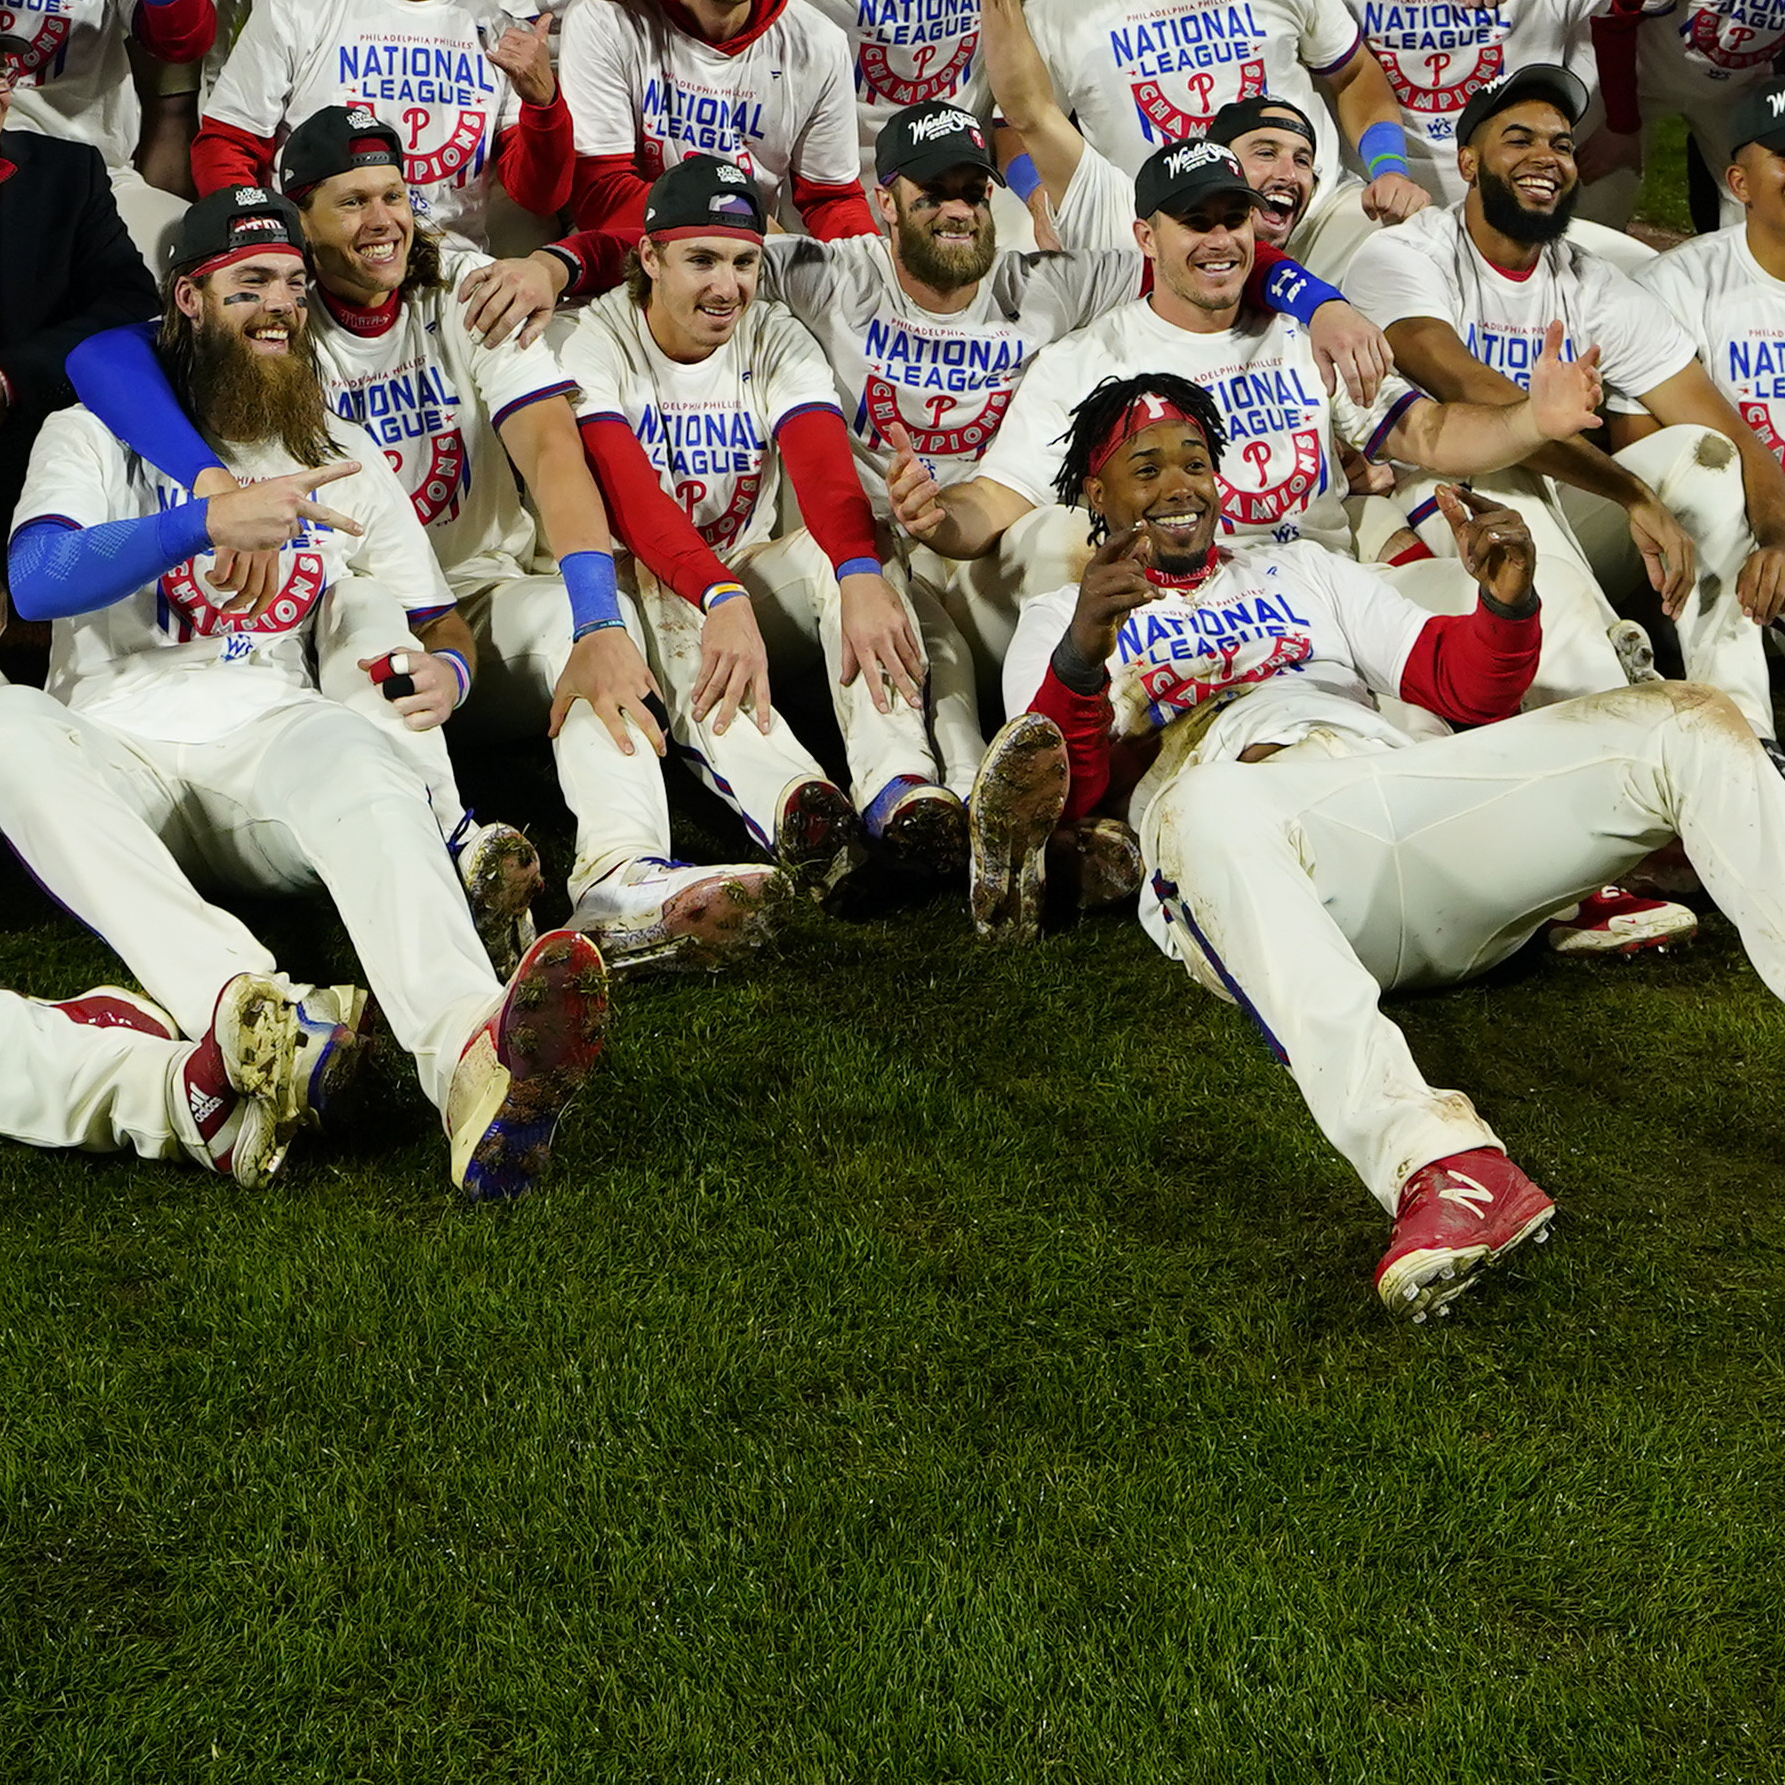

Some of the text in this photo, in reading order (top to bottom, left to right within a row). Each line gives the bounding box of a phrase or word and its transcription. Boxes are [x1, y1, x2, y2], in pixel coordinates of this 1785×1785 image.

[877, 16, 975, 46] LEAGUE
[1365, 2, 1511, 31] NATIONAL
[1111, 3, 1265, 68] NATIONAL
[1383, 30, 1490, 49] LEAGUE
[339, 46, 495, 93] NATIONAL
[1141, 41, 1251, 77] LEAGUE
[363, 79, 473, 106] LEAGUE
[655, 117, 743, 151] LEAGUE
[865, 319, 1024, 373] NATIONAL
[885, 364, 1001, 390] LEAGUE
